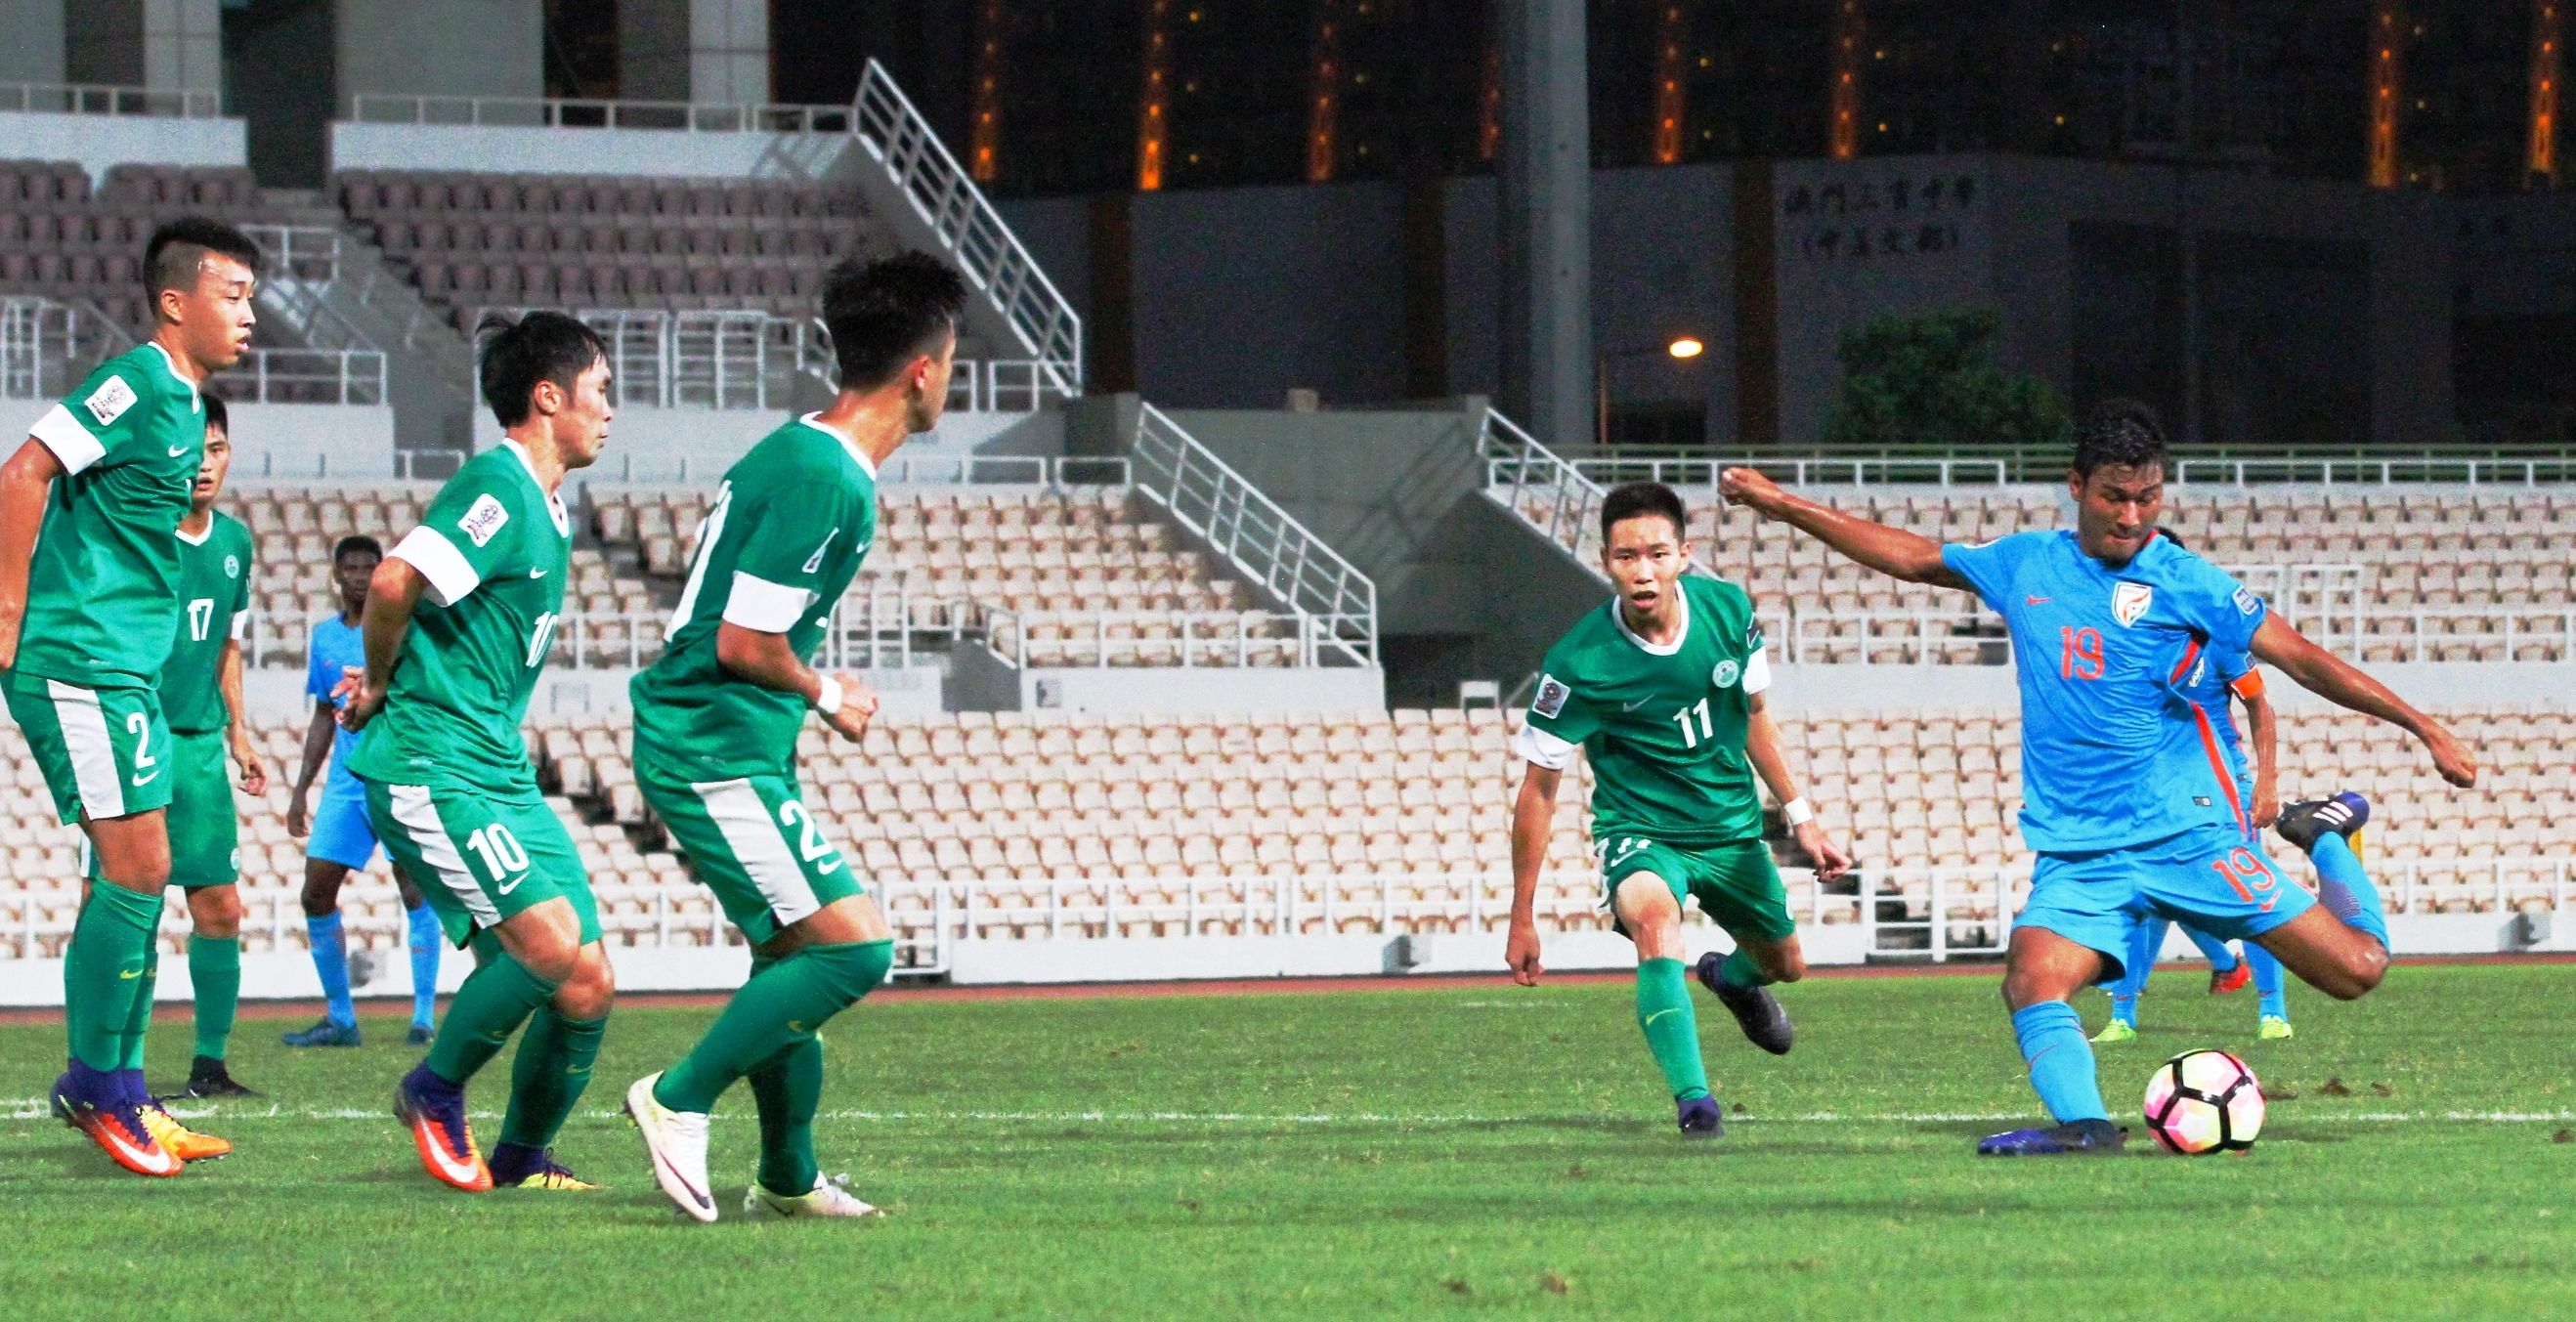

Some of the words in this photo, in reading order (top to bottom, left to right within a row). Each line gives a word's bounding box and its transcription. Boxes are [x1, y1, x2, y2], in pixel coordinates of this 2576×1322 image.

[188, 598, 214, 641] 17
[2060, 625, 2105, 680] 19
[127, 712, 156, 769] 2
[1673, 698, 1713, 748] 11
[466, 823, 530, 882] 10
[779, 799, 833, 863] 2
[2211, 847, 2276, 903] 19
